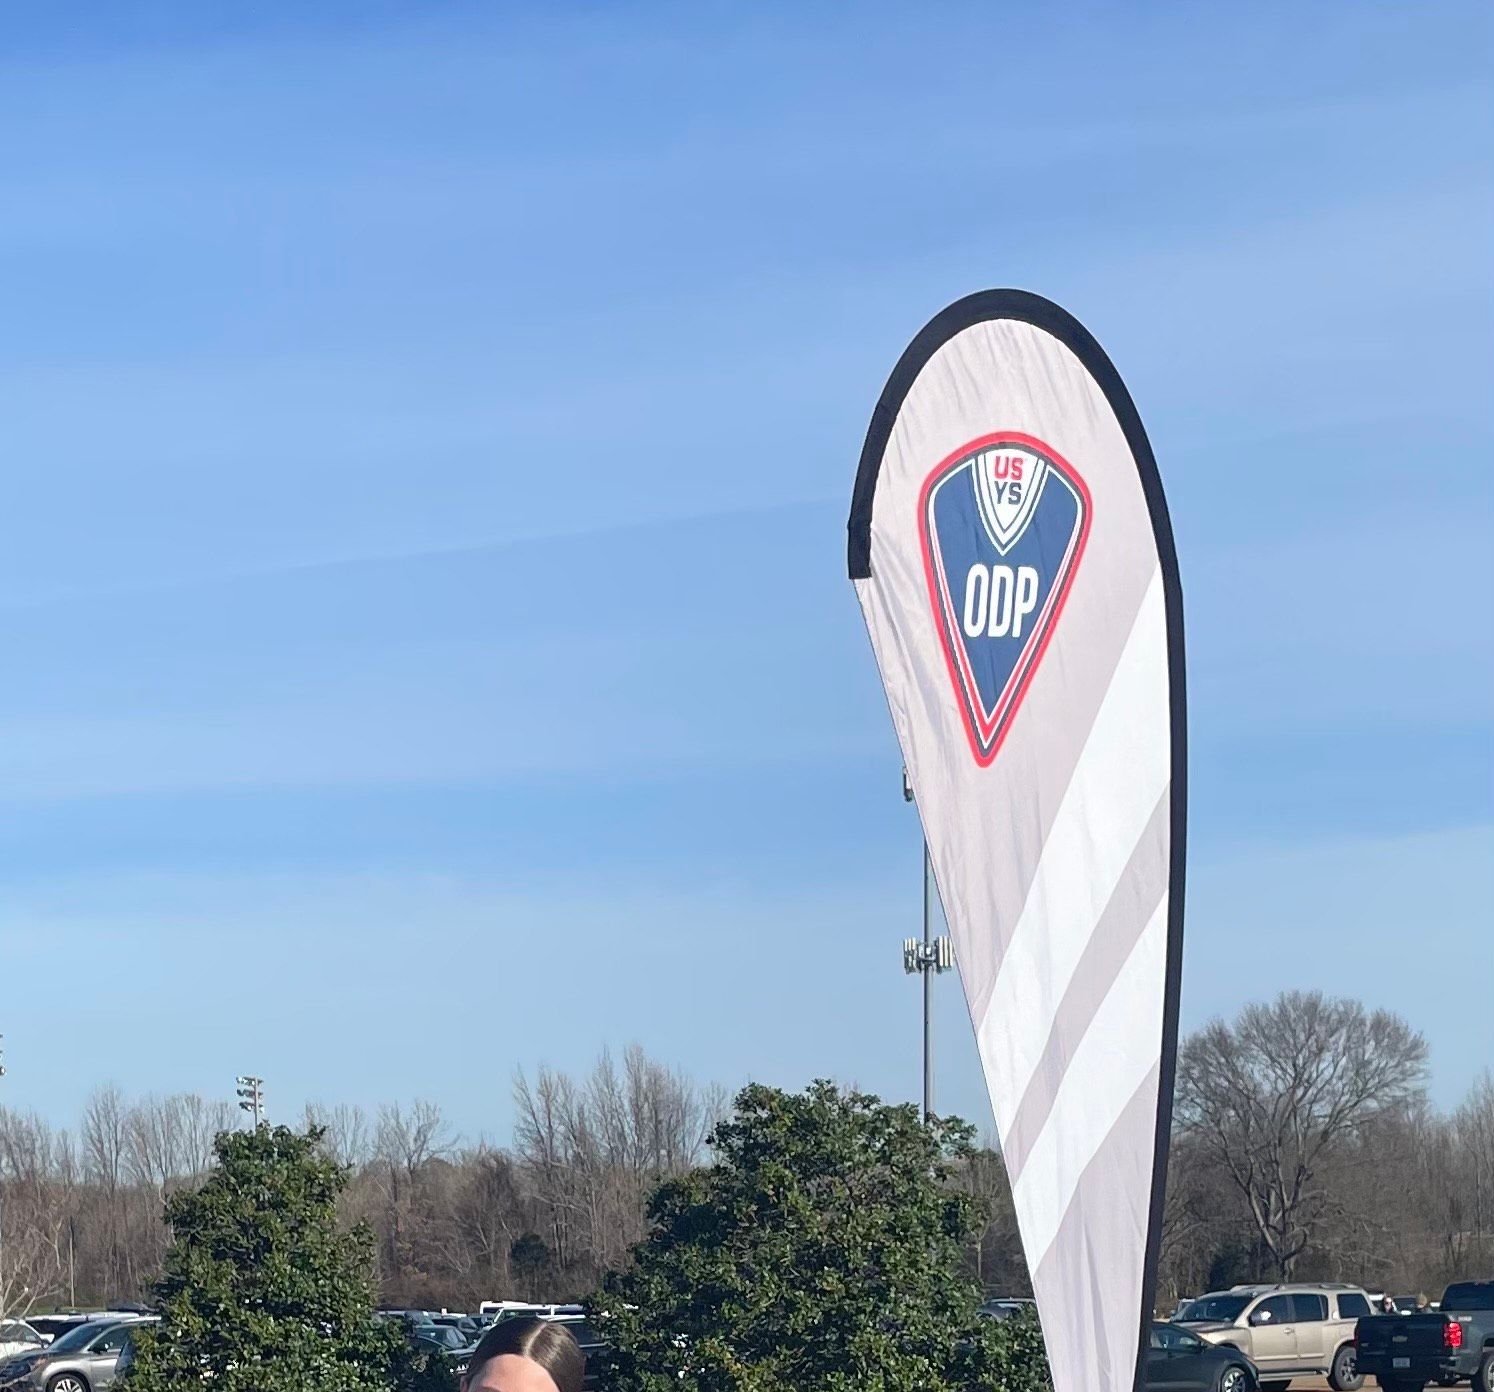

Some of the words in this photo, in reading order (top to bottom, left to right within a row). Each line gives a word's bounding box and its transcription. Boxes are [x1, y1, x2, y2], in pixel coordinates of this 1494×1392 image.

[994, 455, 1024, 481] US
[994, 480, 1022, 505] YS
[963, 563, 1039, 638] ODP
